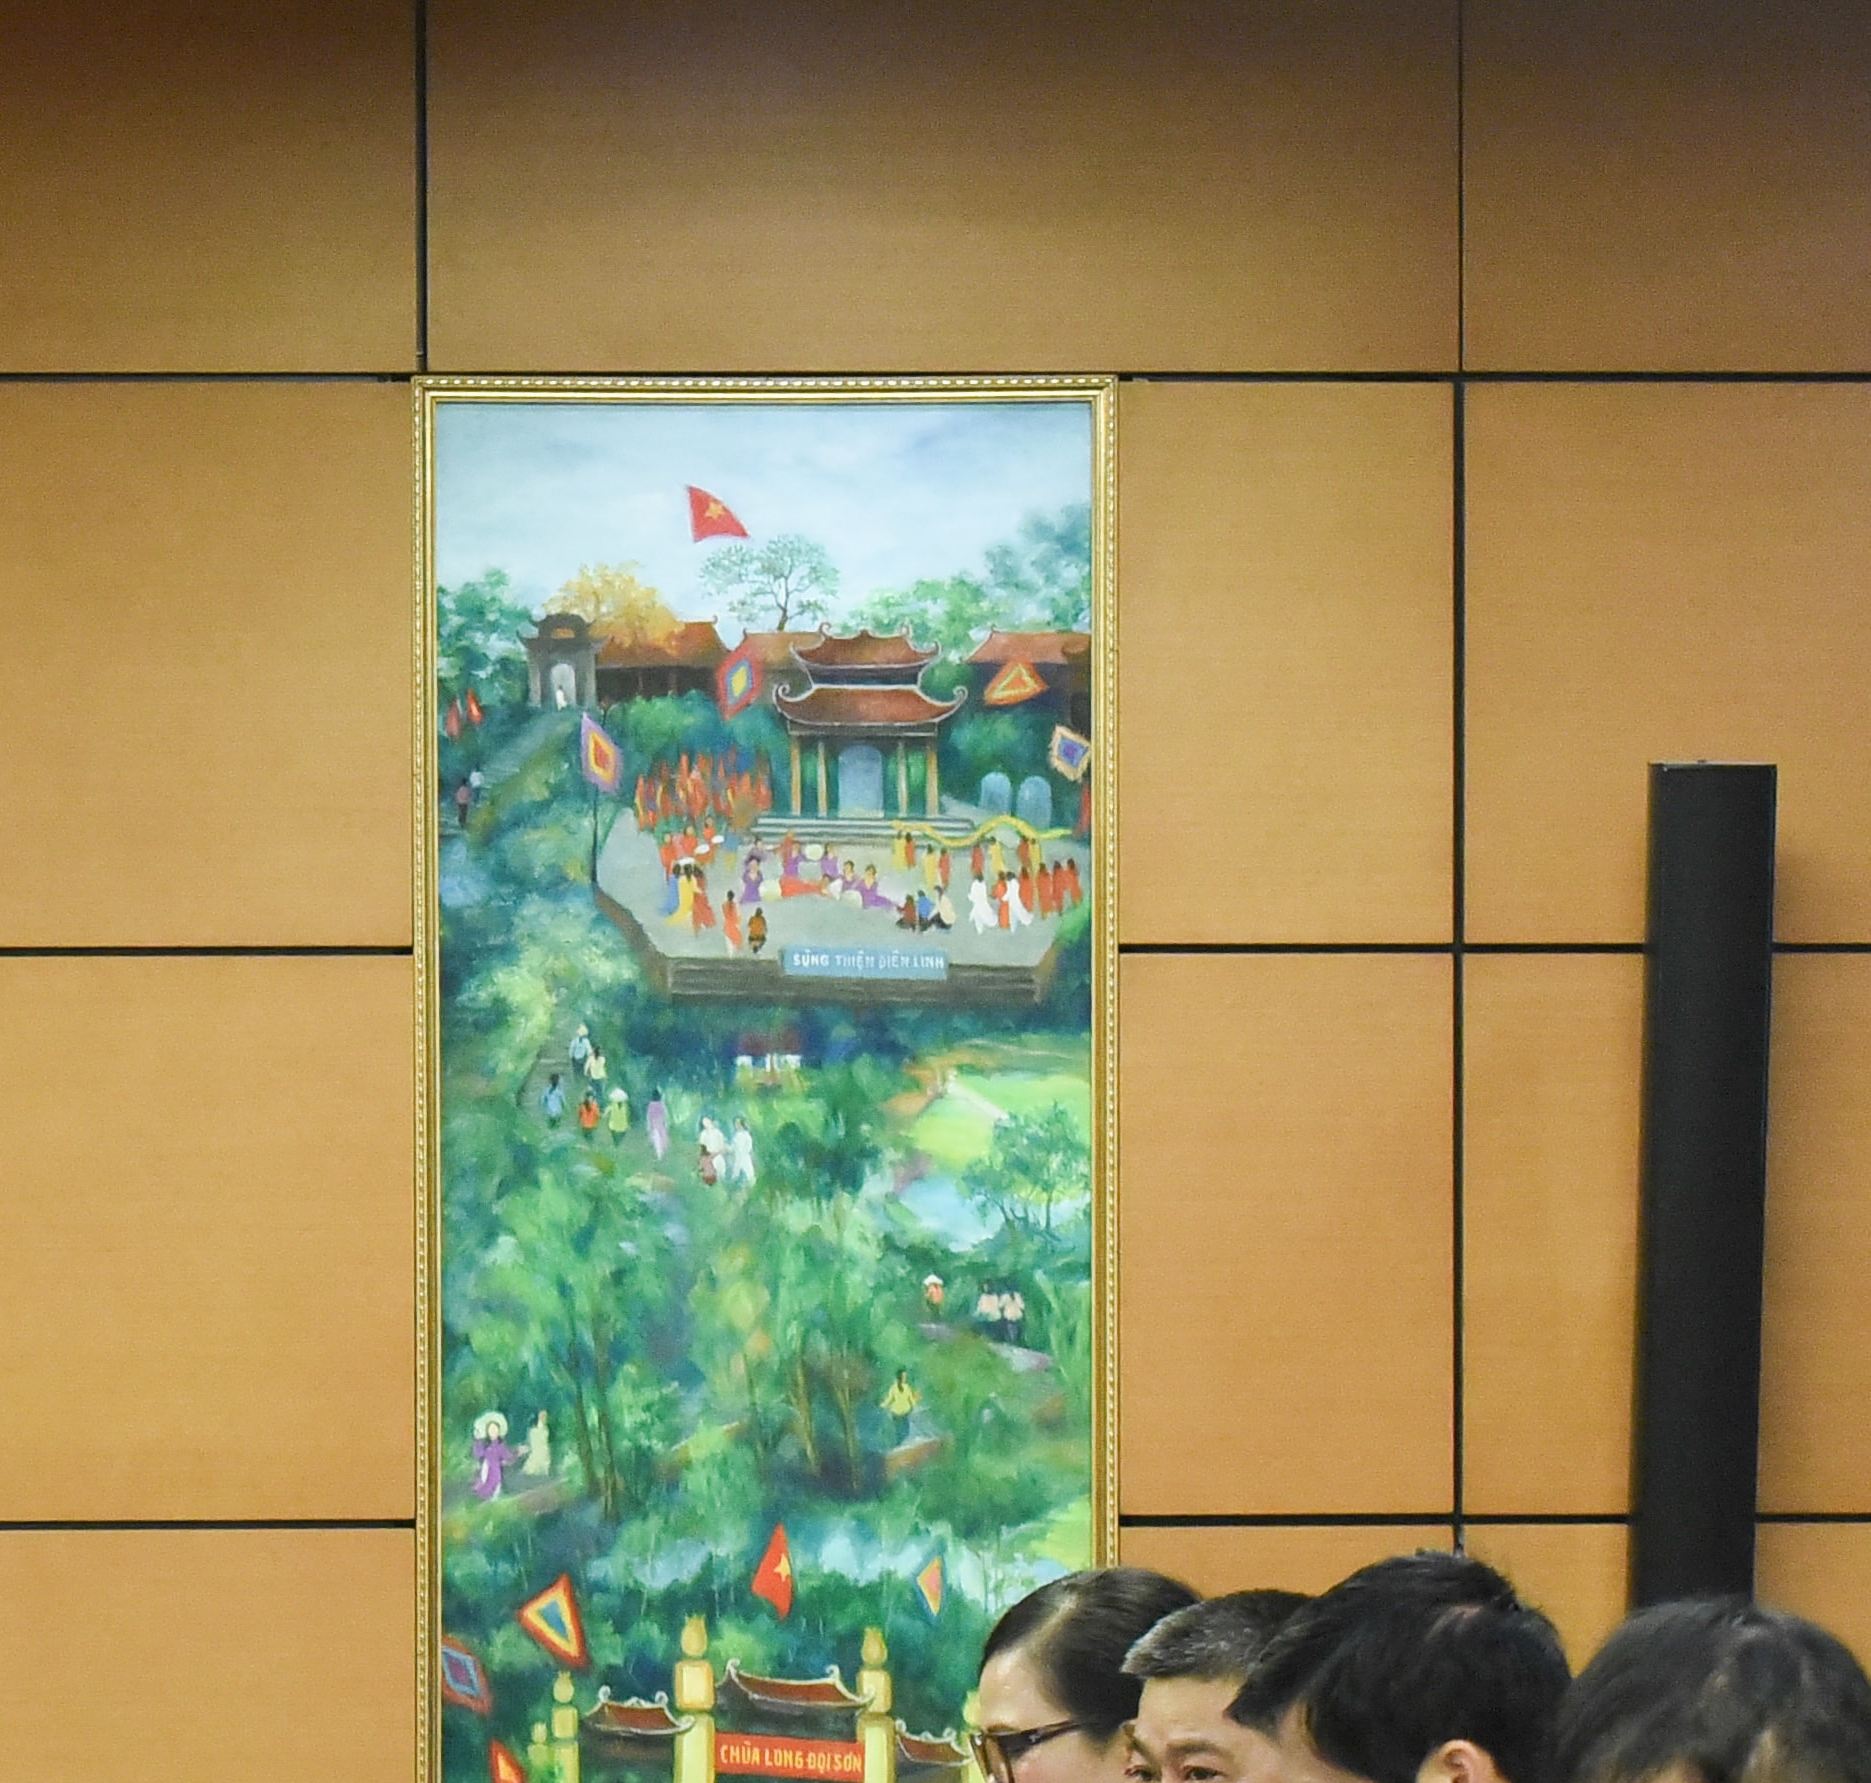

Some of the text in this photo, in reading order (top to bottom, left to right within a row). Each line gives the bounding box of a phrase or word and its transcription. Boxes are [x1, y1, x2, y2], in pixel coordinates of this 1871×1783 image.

[764, 1748, 804, 1769] LONG
[806, 1752, 831, 1775] ĐỌI
[833, 1751, 862, 1773] SƠN
